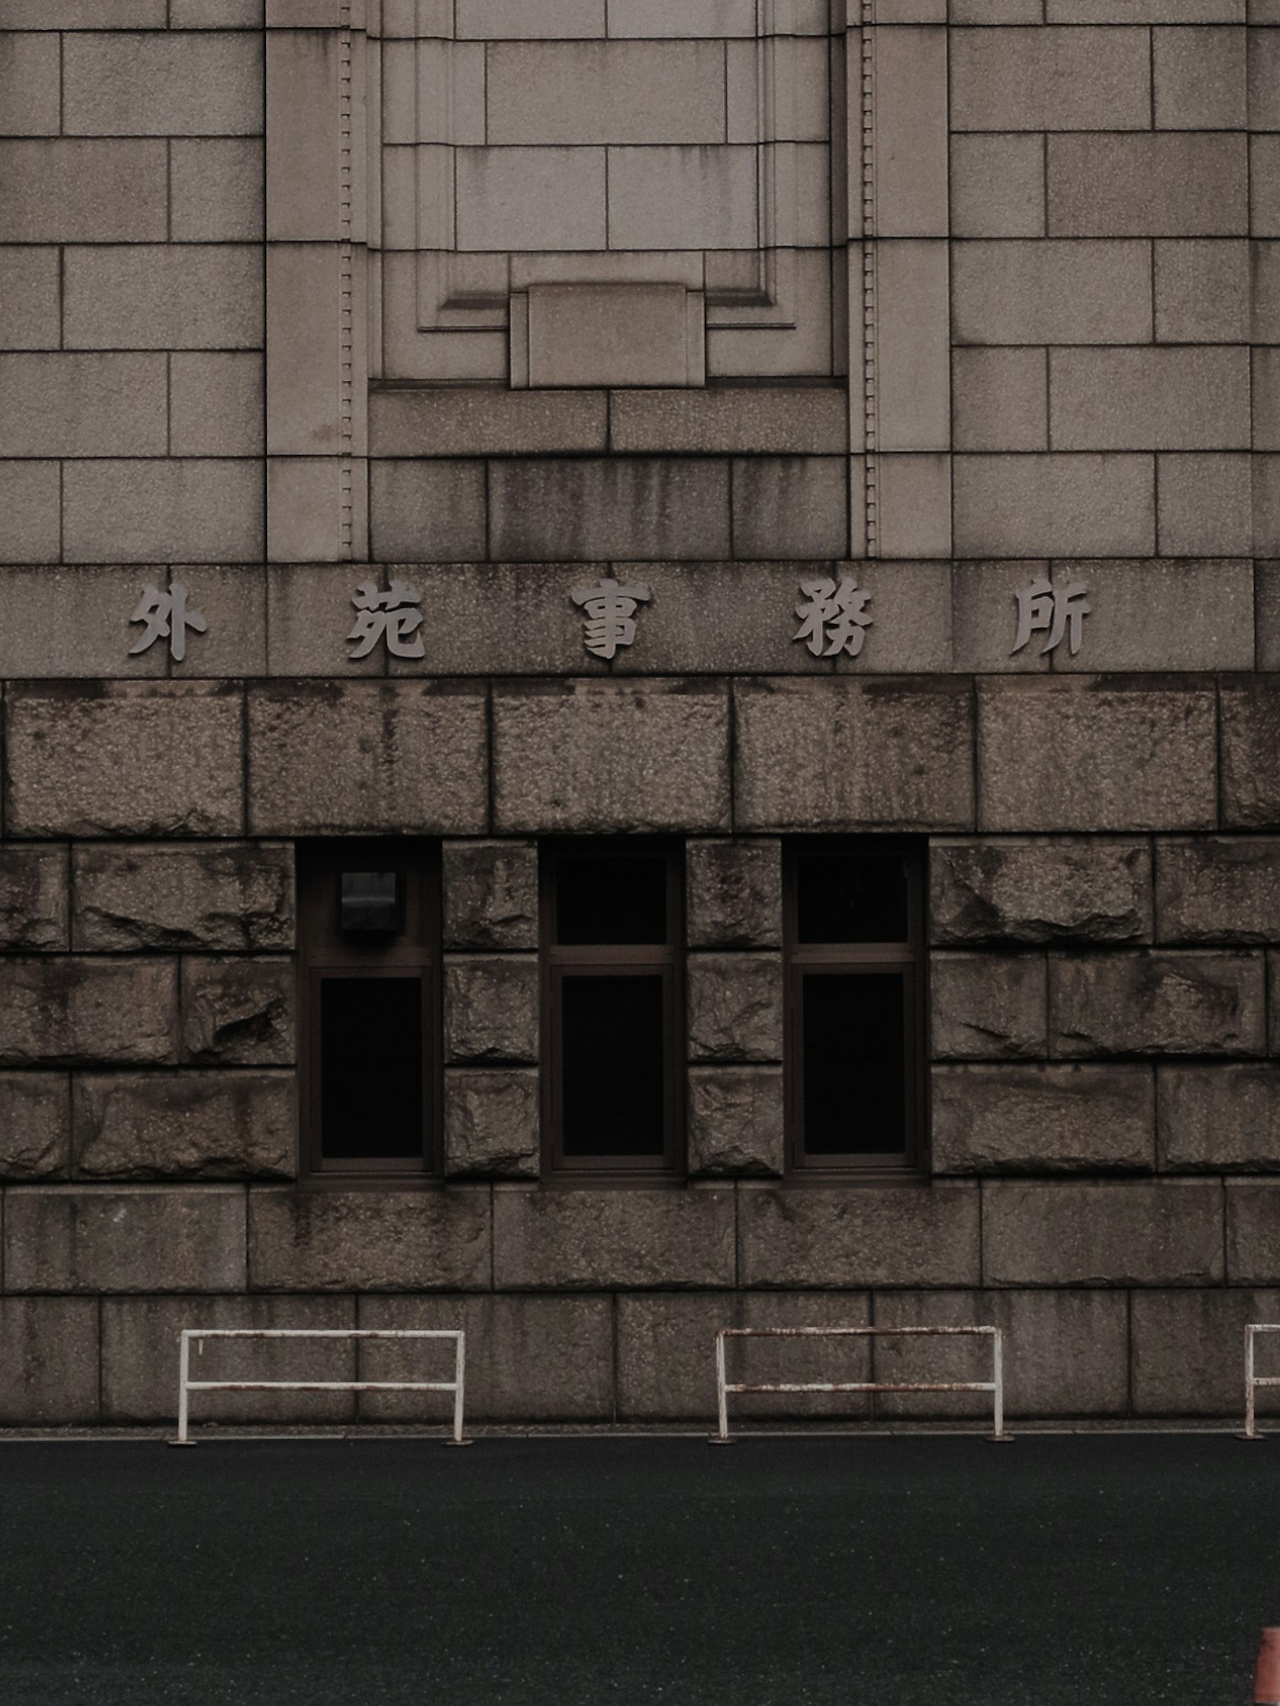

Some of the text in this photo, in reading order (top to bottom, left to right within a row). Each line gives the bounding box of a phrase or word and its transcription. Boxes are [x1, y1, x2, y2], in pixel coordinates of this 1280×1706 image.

[128, 577, 1092, 662] 外苑事務所
